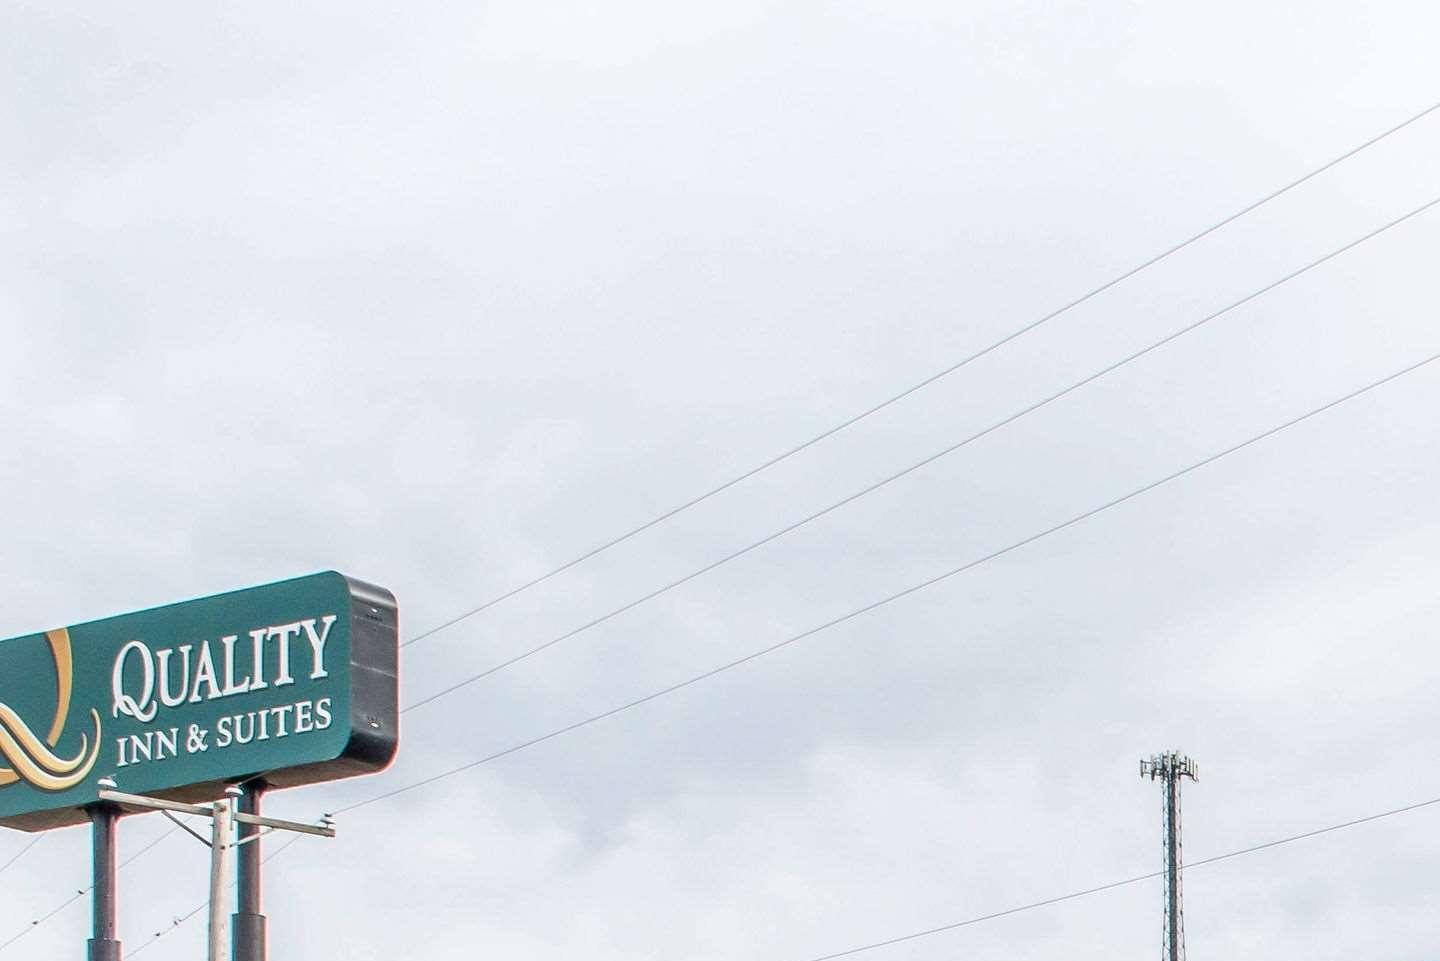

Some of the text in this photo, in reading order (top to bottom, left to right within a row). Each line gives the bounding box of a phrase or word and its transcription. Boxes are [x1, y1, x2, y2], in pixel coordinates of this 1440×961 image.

[112, 615, 337, 722] QUALITY
[117, 698, 332, 766] INN & SUITES
